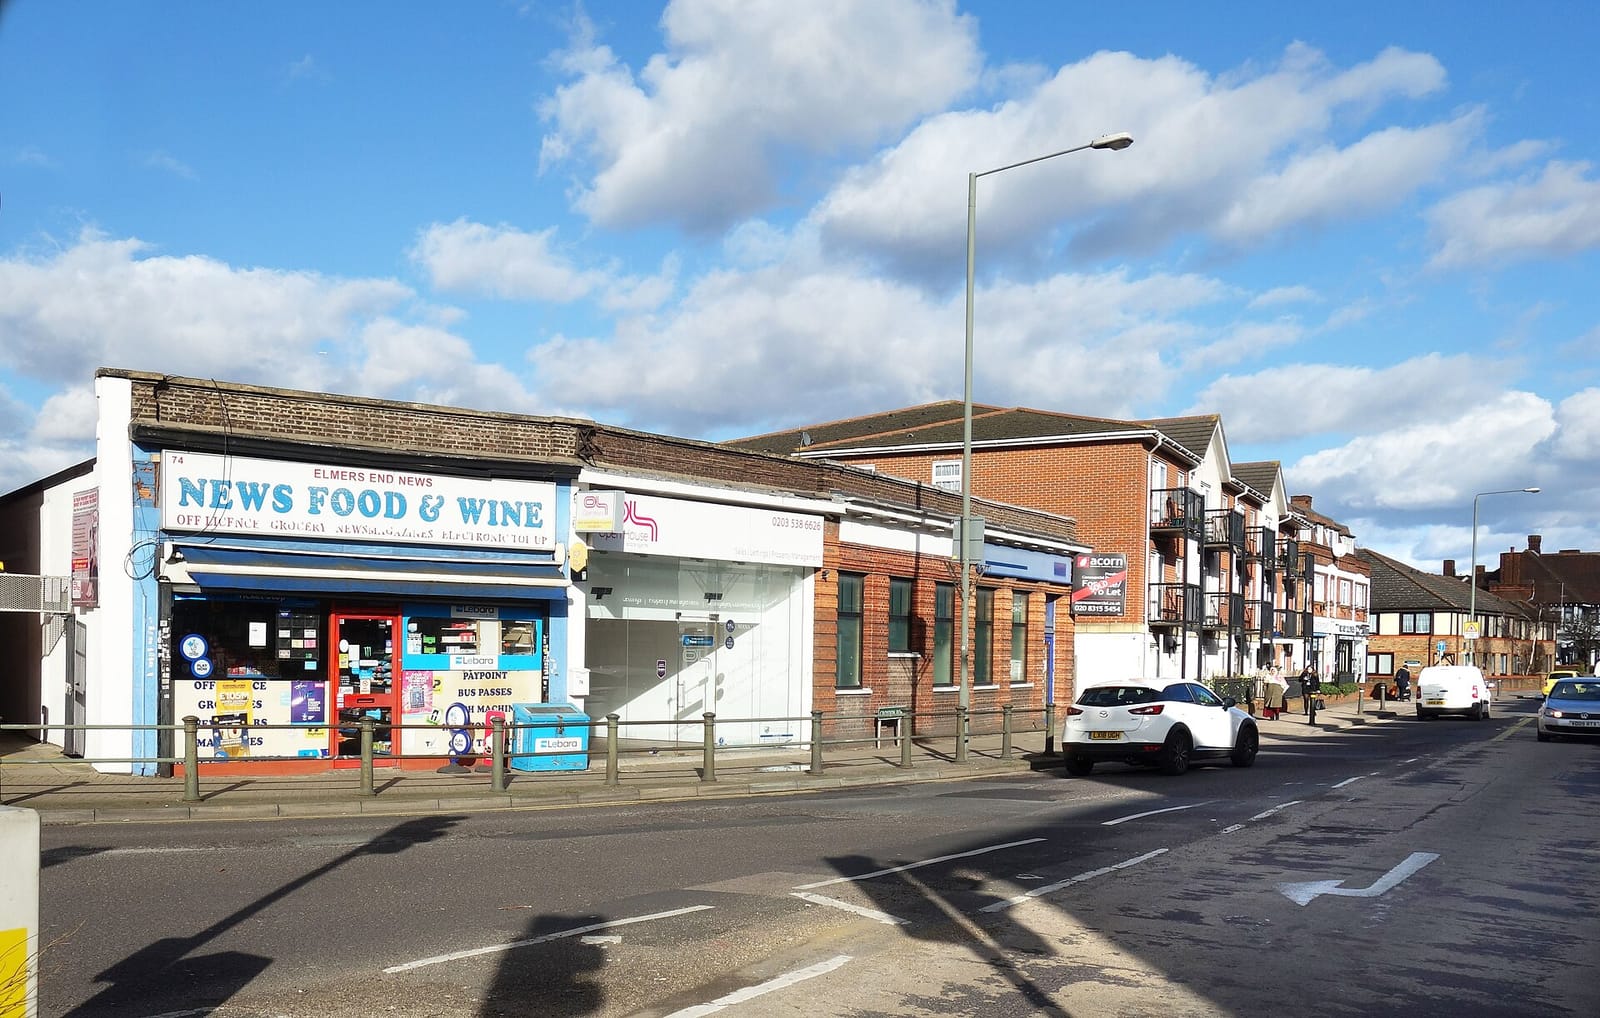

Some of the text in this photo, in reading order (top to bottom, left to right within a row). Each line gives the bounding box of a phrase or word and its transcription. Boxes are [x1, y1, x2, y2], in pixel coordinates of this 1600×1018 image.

[171, 455, 184, 464] 74
[314, 468, 433, 488] ELMERS END NEWS
[178, 477, 544, 528] NEWS FOOD & WINE
[177, 514, 201, 526] OFF
[772, 516, 789, 528] 0203
[804, 520, 821, 531] 6626
[1090, 557, 1123, 566] acorn
[463, 604, 495, 614] Lebara
[462, 657, 494, 665] Lebara
[463, 671, 508, 681] PAYPOINT
[194, 681, 216, 690] OFF
[457, 688, 513, 697] BUS PASSES
[547, 740, 578, 748] Lebara
